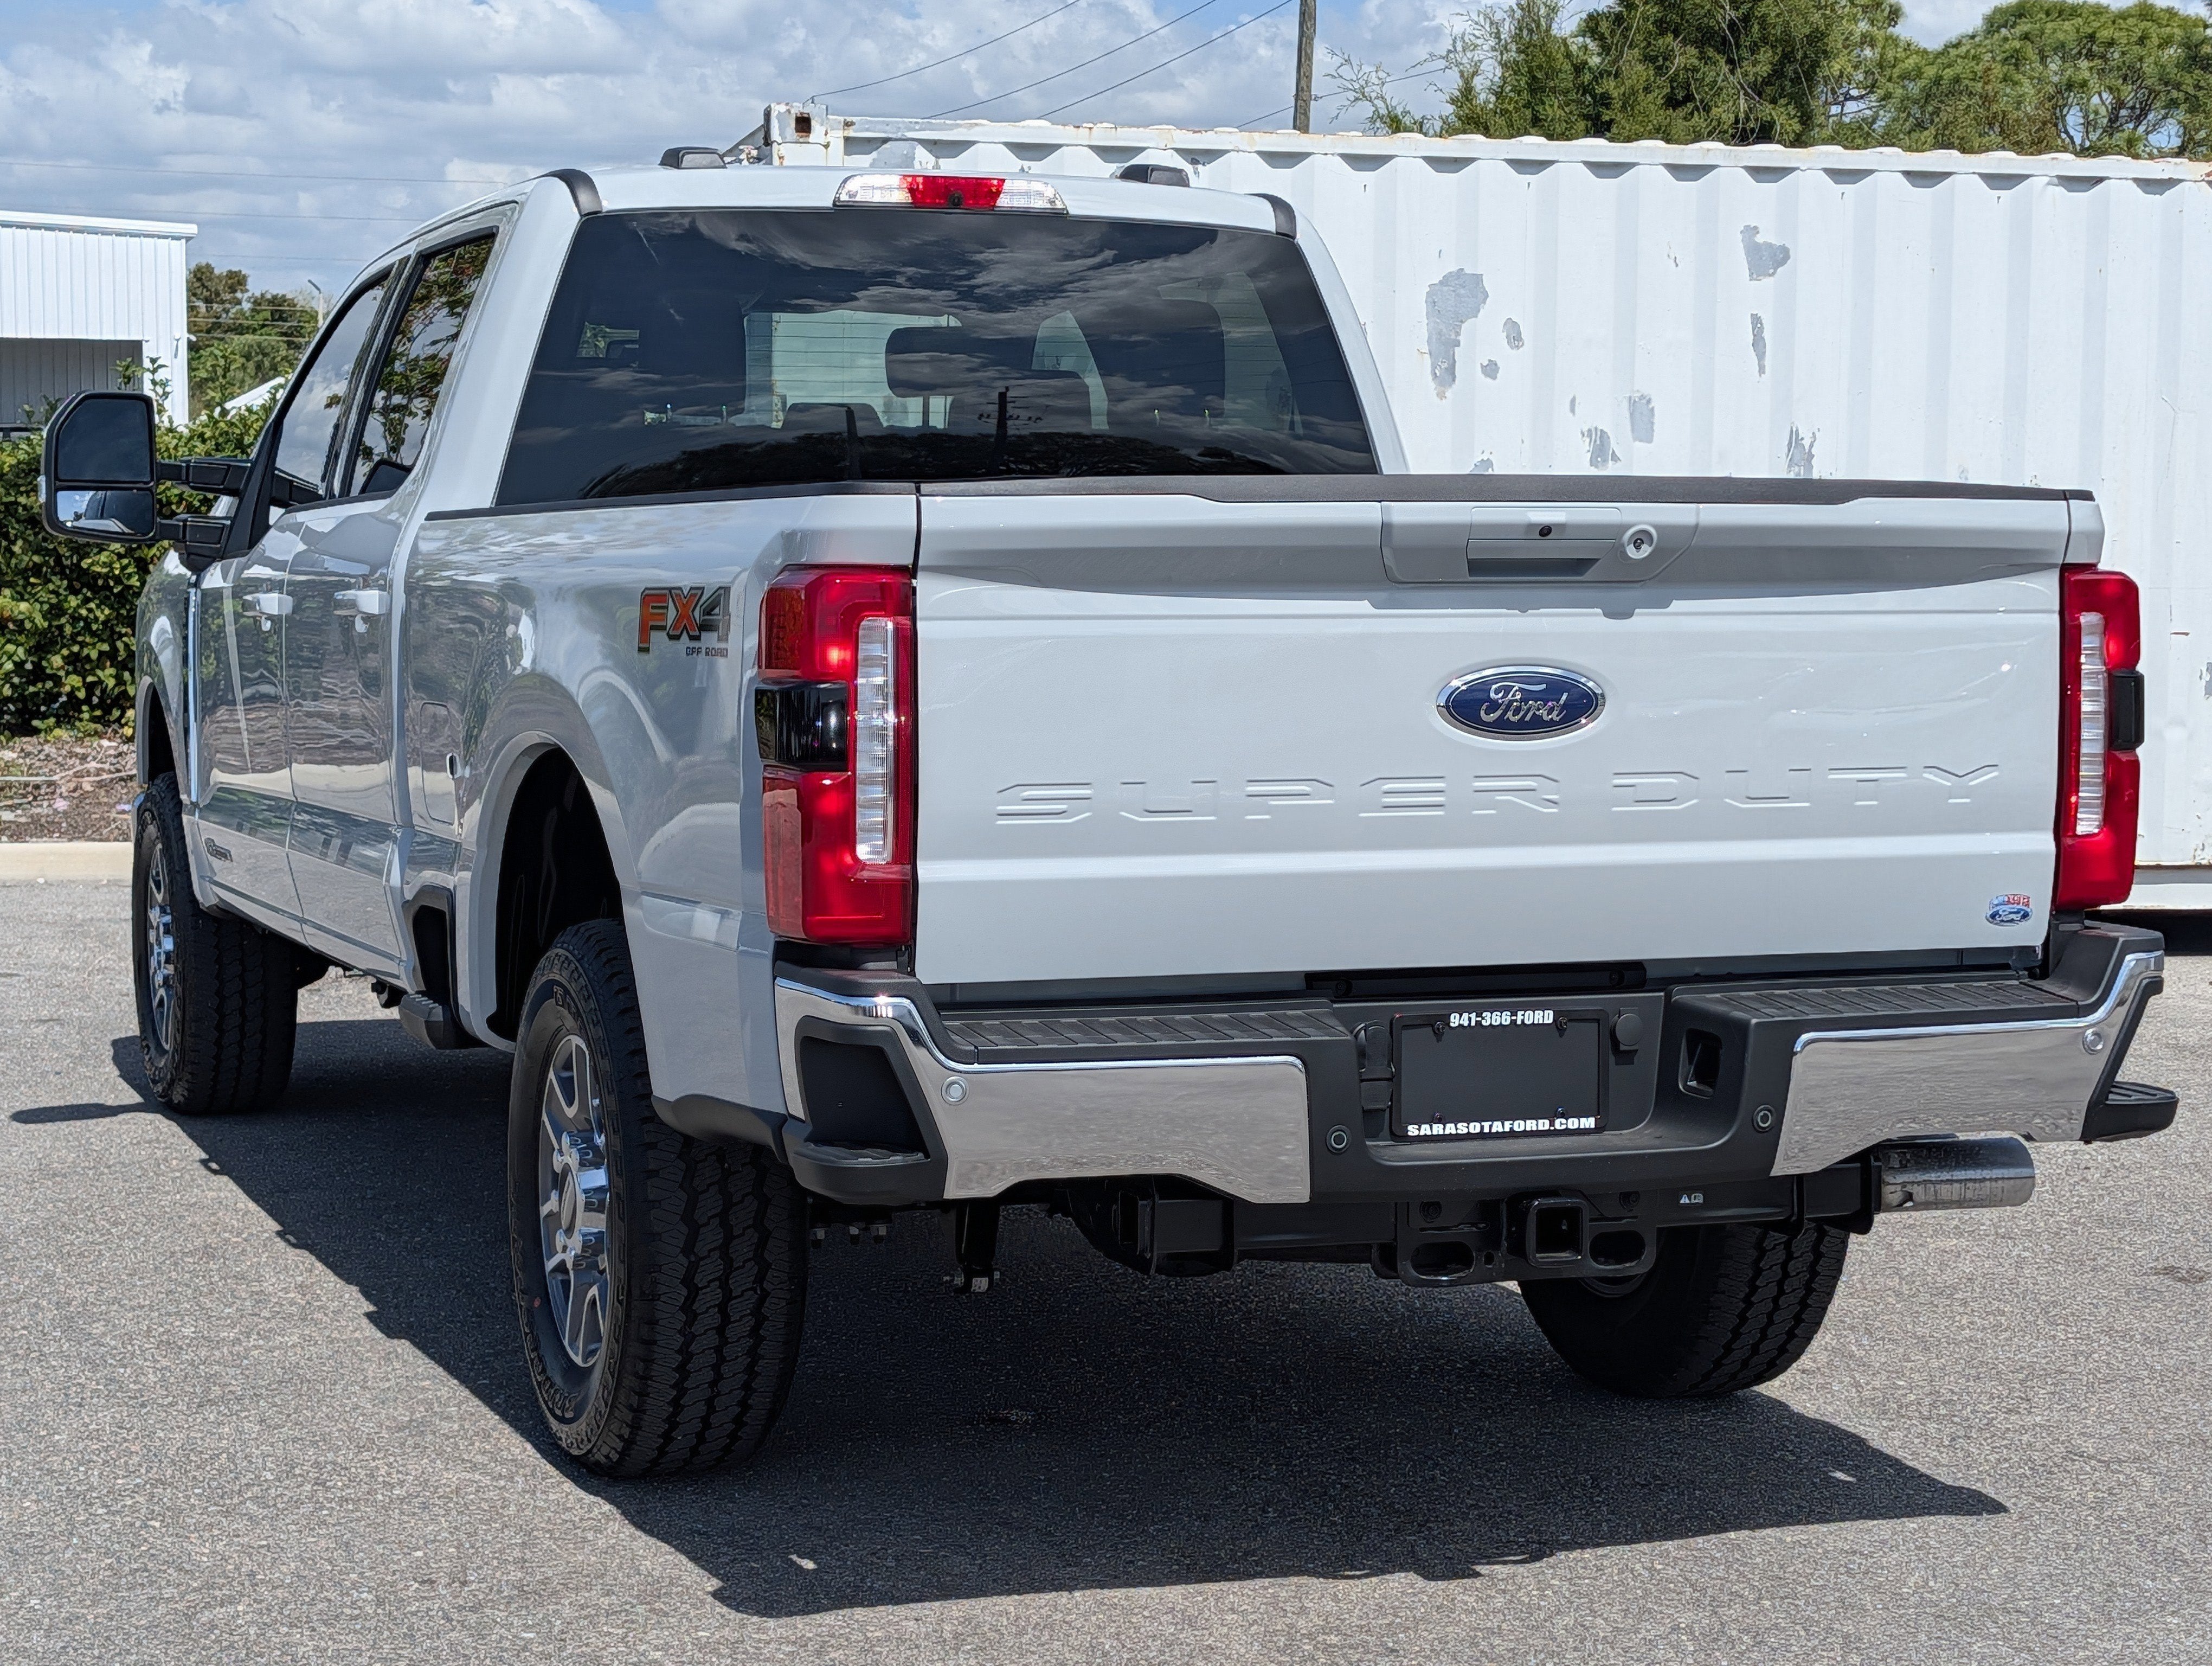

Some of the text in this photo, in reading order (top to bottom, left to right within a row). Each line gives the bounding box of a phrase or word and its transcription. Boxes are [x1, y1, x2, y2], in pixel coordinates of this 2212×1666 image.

[638, 587, 731, 652] FX4
[685, 646, 728, 658] OFF ROAD
[1480, 682, 1568, 722] Ford
[996, 764, 1999, 824] SUPER DUTY
[1449, 1010, 1554, 1027] 941-366-FORD
[1407, 1117, 1596, 1136] SARASOTAFORD.COM
